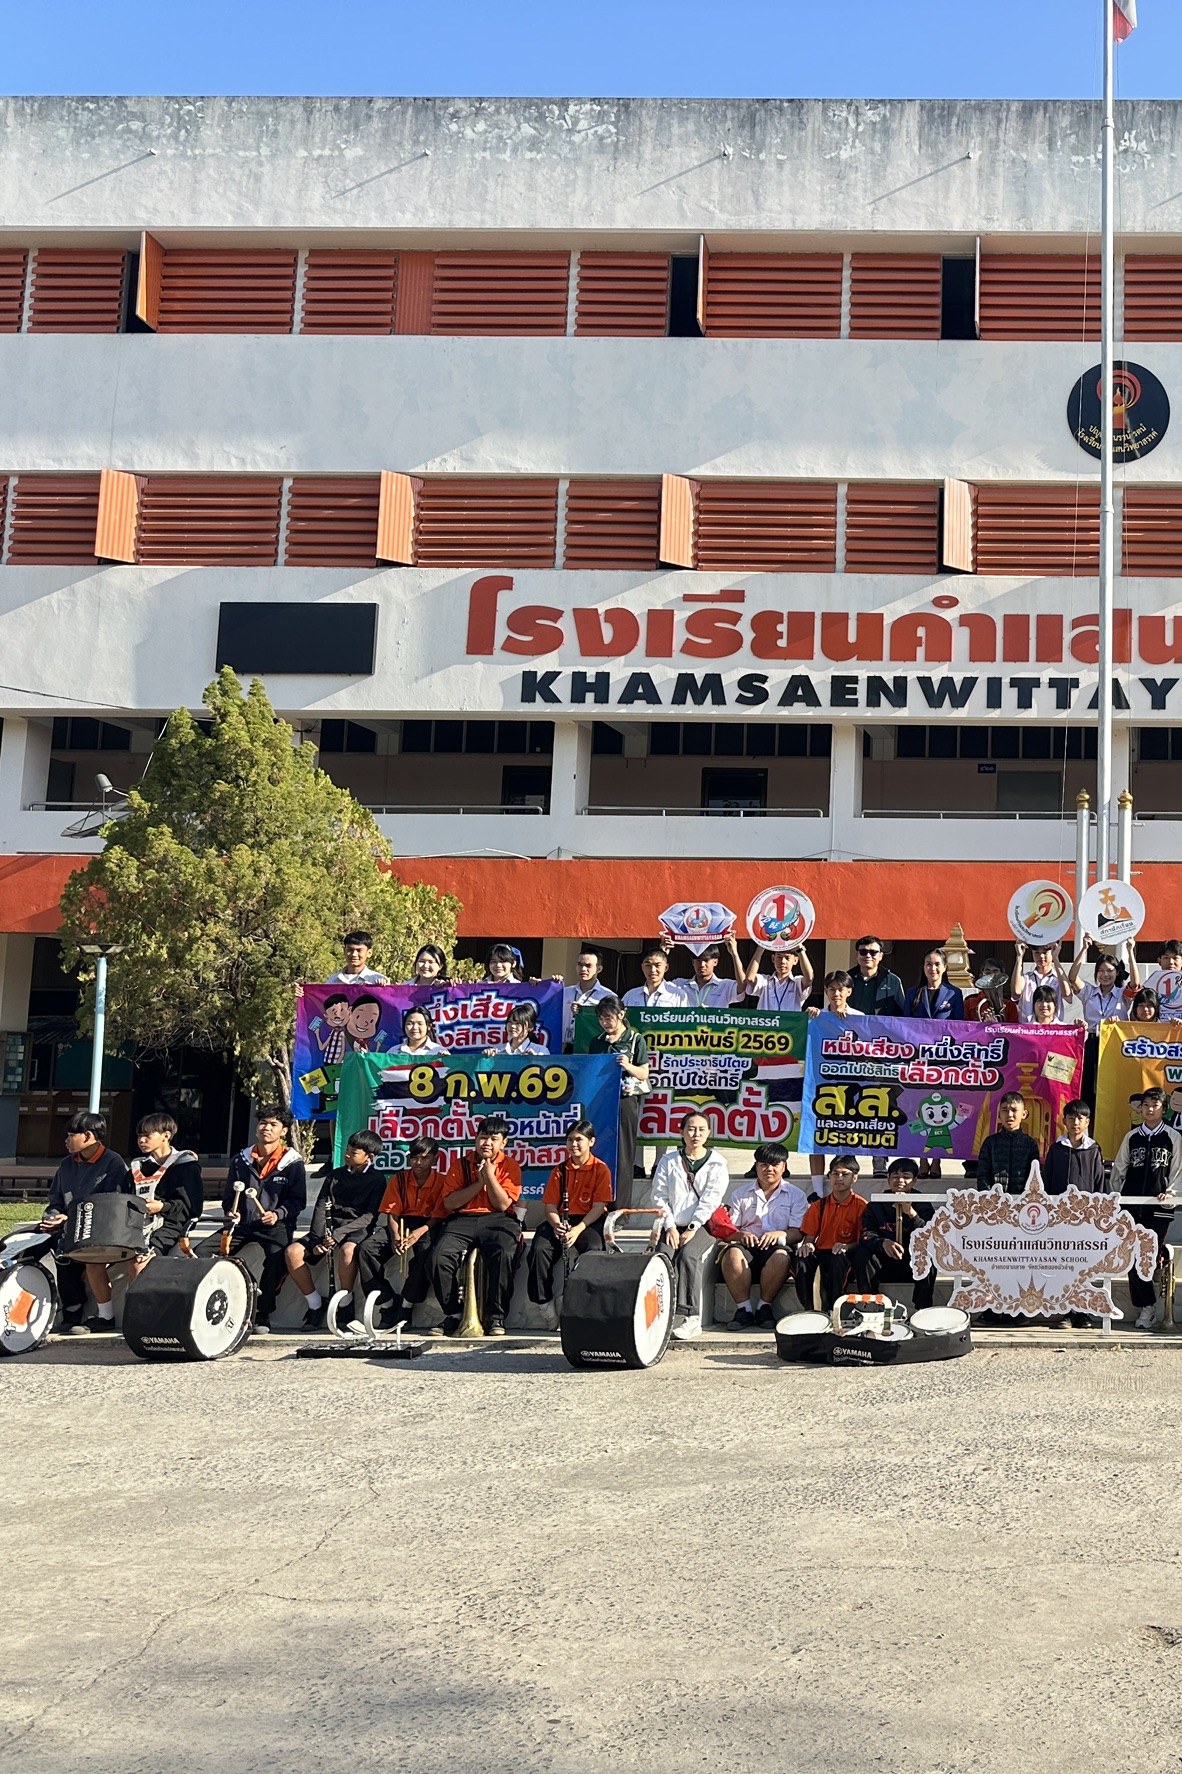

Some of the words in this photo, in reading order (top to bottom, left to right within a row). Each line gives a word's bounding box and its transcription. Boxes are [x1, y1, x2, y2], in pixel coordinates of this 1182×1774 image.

[772, 894, 786, 922] 1
[768, 921, 780, 930] BE
[1162, 977, 1172, 999] 1
[639, 1010, 781, 1028] โรงเรียนคำแสนวิทยาสรรค์
[740, 1033, 791, 1052] 2569
[823, 1031, 915, 1059] หนึ่งเสียง
[920, 1036, 1004, 1062] หนึ่งสิทธิ์
[409, 1066, 435, 1098] 8
[445, 1066, 569, 1100] ก.พ.69
[815, 1086, 900, 1118] ส.ส.
[638, 1086, 790, 1140] ลือกตั้ง
[815, 1117, 896, 1131] และออกเสียง
[814, 1130, 896, 1147] ประชามติ
[82, 1210, 93, 1241] YAMAHA
[961, 1235, 1109, 1251] โรงเรียนคำแสนวิทยาสรรค์
[973, 1256, 1058, 1264] KHAMSAENWITTAYASAN
[1060, 1256, 1089, 1264] SCHOOL
[149, 1337, 181, 1345] YAMAHA
[589, 1350, 622, 1358] YAMAHA
[842, 1348, 873, 1359] YAMAHA
